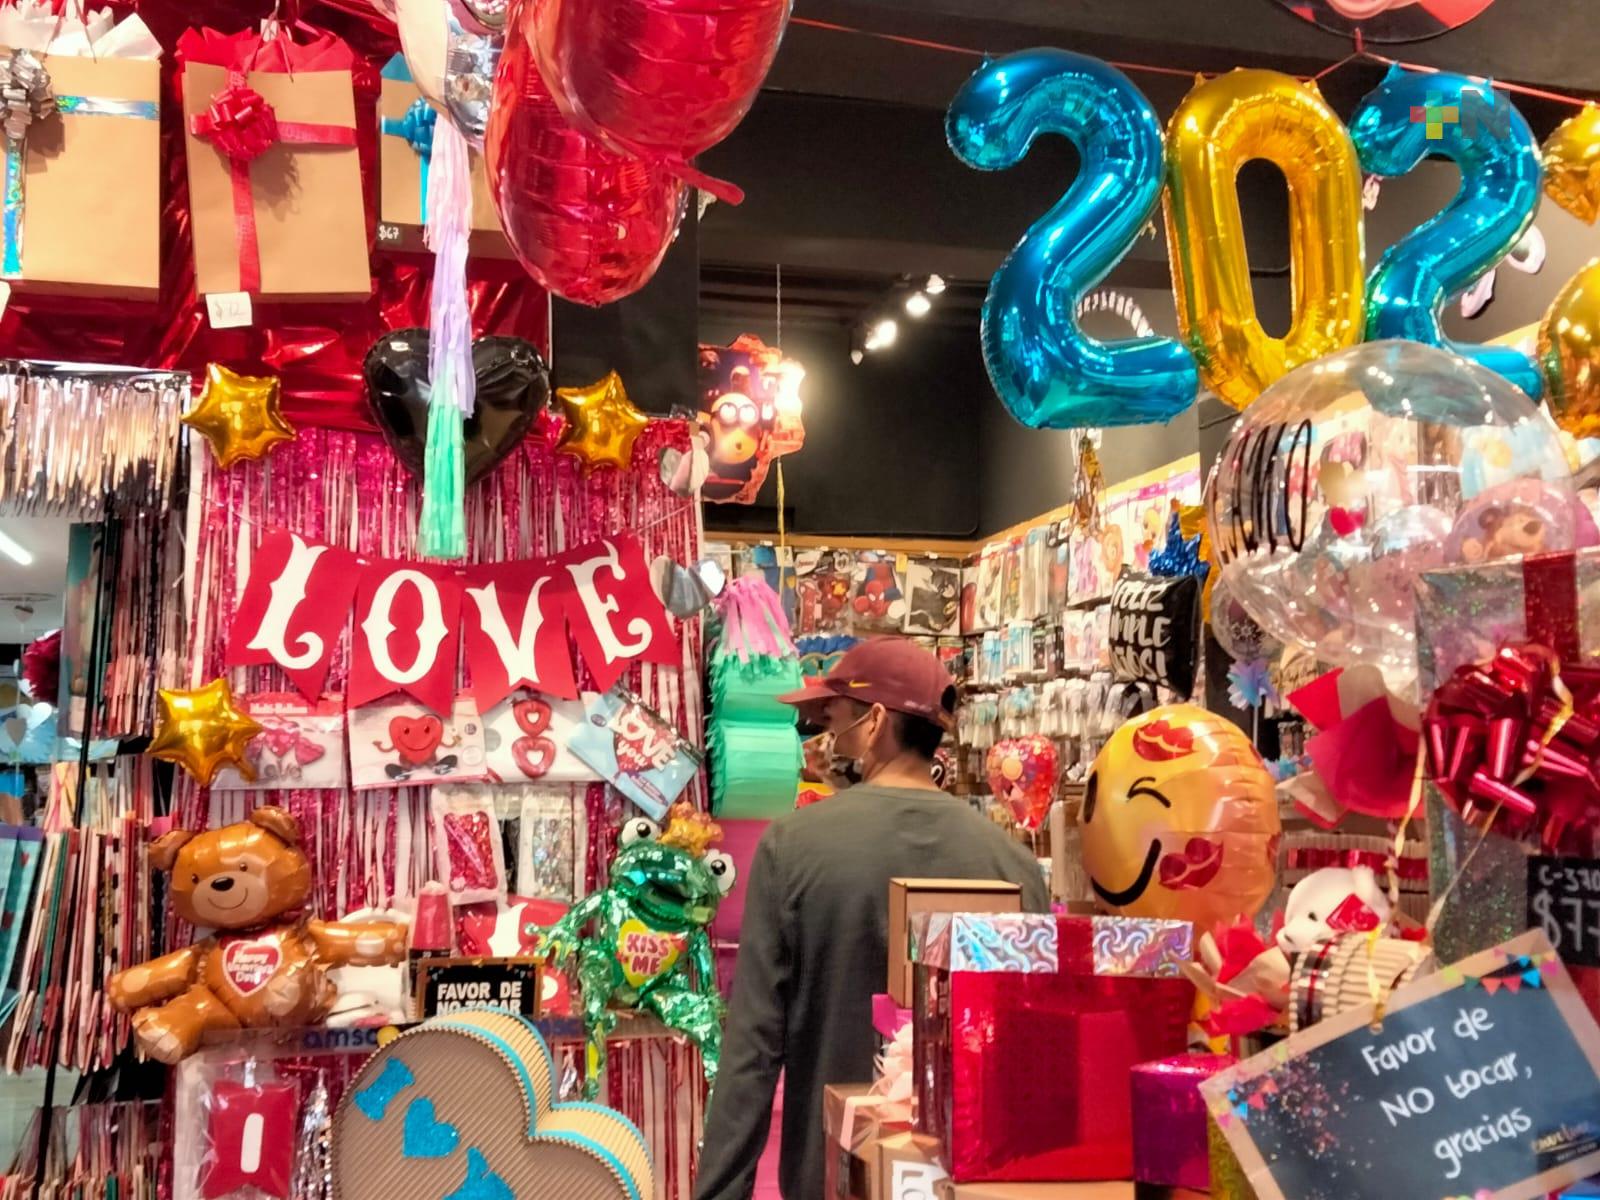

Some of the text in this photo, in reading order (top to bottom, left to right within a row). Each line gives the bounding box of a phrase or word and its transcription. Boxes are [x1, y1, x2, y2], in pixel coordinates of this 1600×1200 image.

[247, 532, 653, 685] LOVE
[627, 933, 669, 957] KISS
[632, 955, 660, 975] ME
[437, 982, 491, 1000] FAVOR
[499, 980, 522, 999] DE
[1361, 1007, 1496, 1076] Favor de
[1379, 1087, 1435, 1127] NO
[1434, 1107, 1532, 1179] gracias
